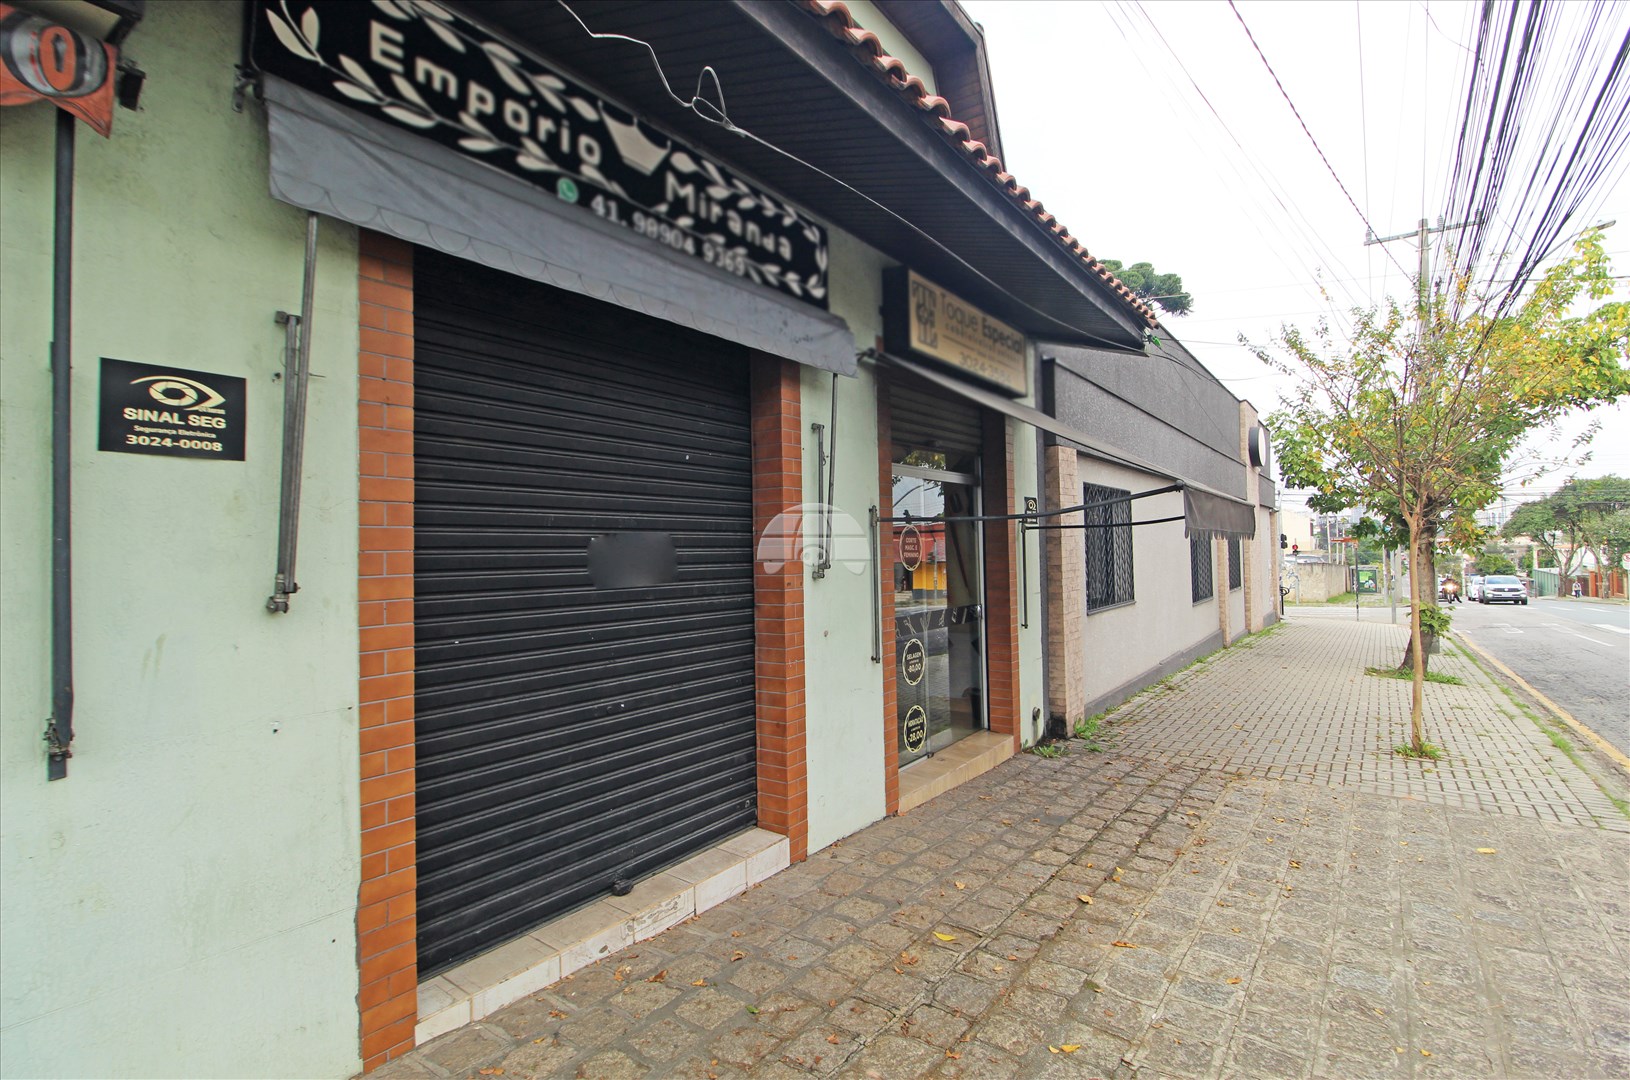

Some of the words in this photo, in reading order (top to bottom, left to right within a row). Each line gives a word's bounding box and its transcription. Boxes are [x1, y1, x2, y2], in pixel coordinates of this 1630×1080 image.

[666, 170, 792, 261] Miranda
[939, 291, 978, 332] Toque
[123, 408, 185, 425] SINAL
[188, 415, 226, 429] SEG
[134, 426, 177, 435] Segurança
[125, 435, 222, 451] 3024-0008
